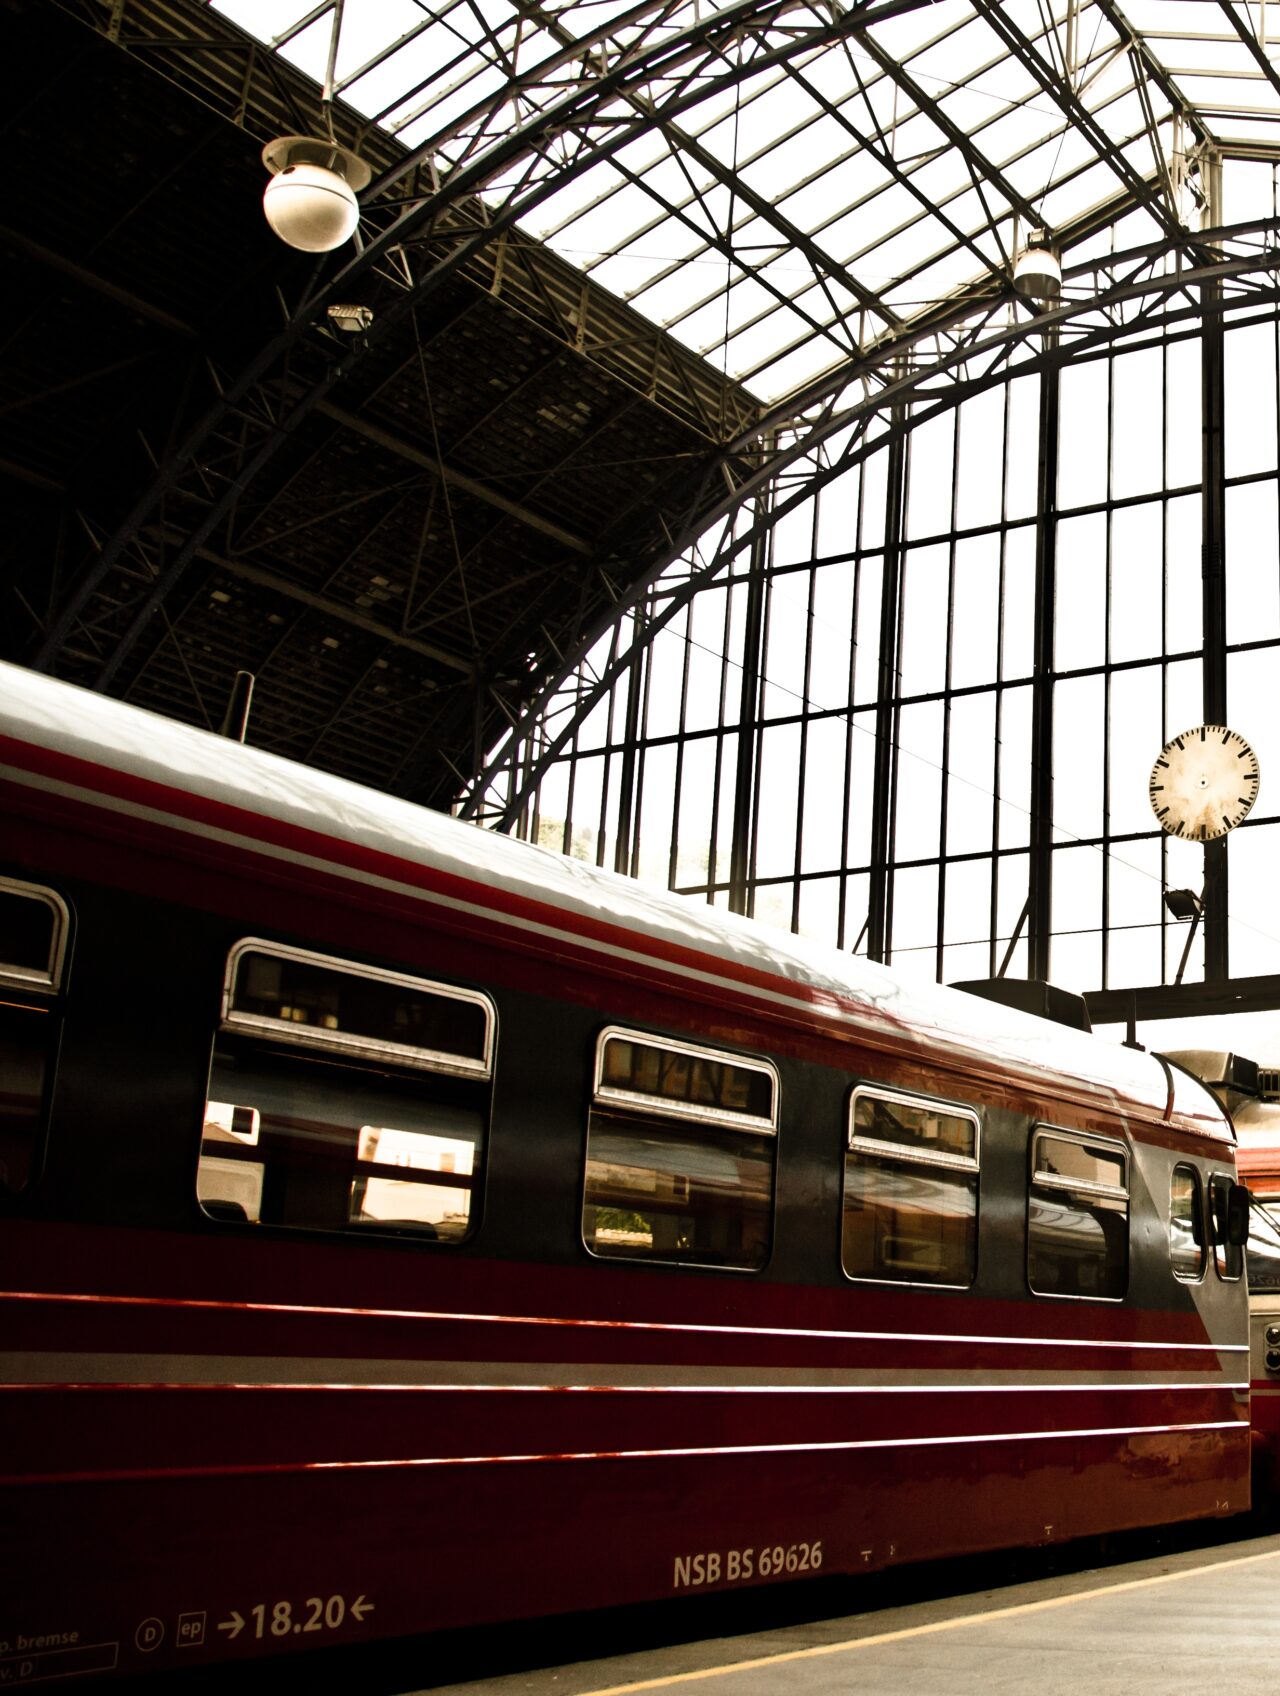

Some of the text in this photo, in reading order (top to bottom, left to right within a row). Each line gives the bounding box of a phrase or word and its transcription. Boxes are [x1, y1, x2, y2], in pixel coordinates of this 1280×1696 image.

[673, 1541, 823, 1588] NSB BS 69626
[252, 1595, 346, 1639] 18.20
[143, 1627, 156, 1643] D
[181, 1620, 202, 1639] ep
[17, 1631, 79, 1651] bremse
[20, 1661, 33, 1677] D
